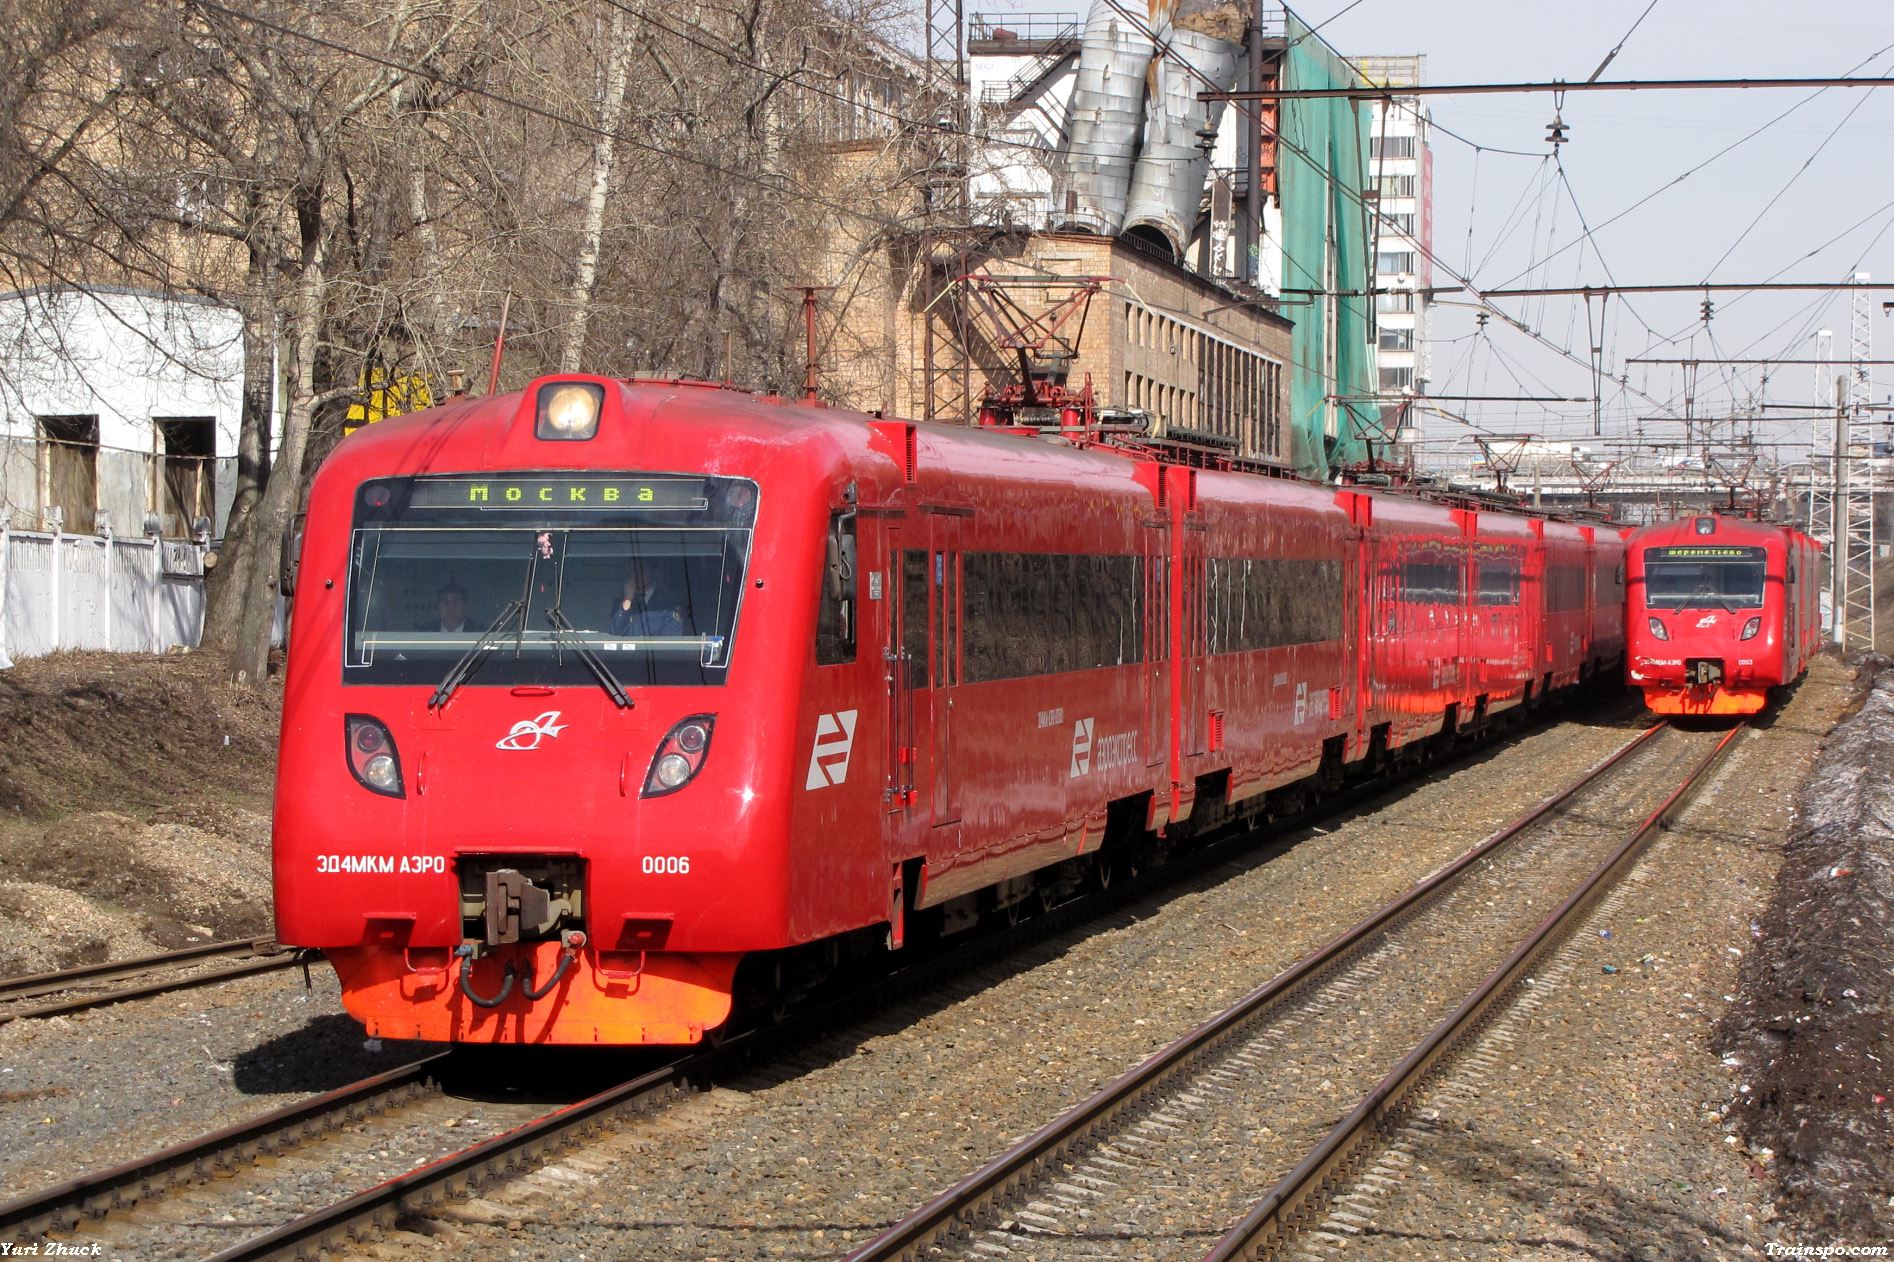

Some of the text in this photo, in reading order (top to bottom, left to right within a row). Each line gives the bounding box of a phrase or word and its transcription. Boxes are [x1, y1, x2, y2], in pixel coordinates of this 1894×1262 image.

[316, 855, 445, 874] ЭД4МКМ АЭРО
[642, 856, 690, 874] 0006
